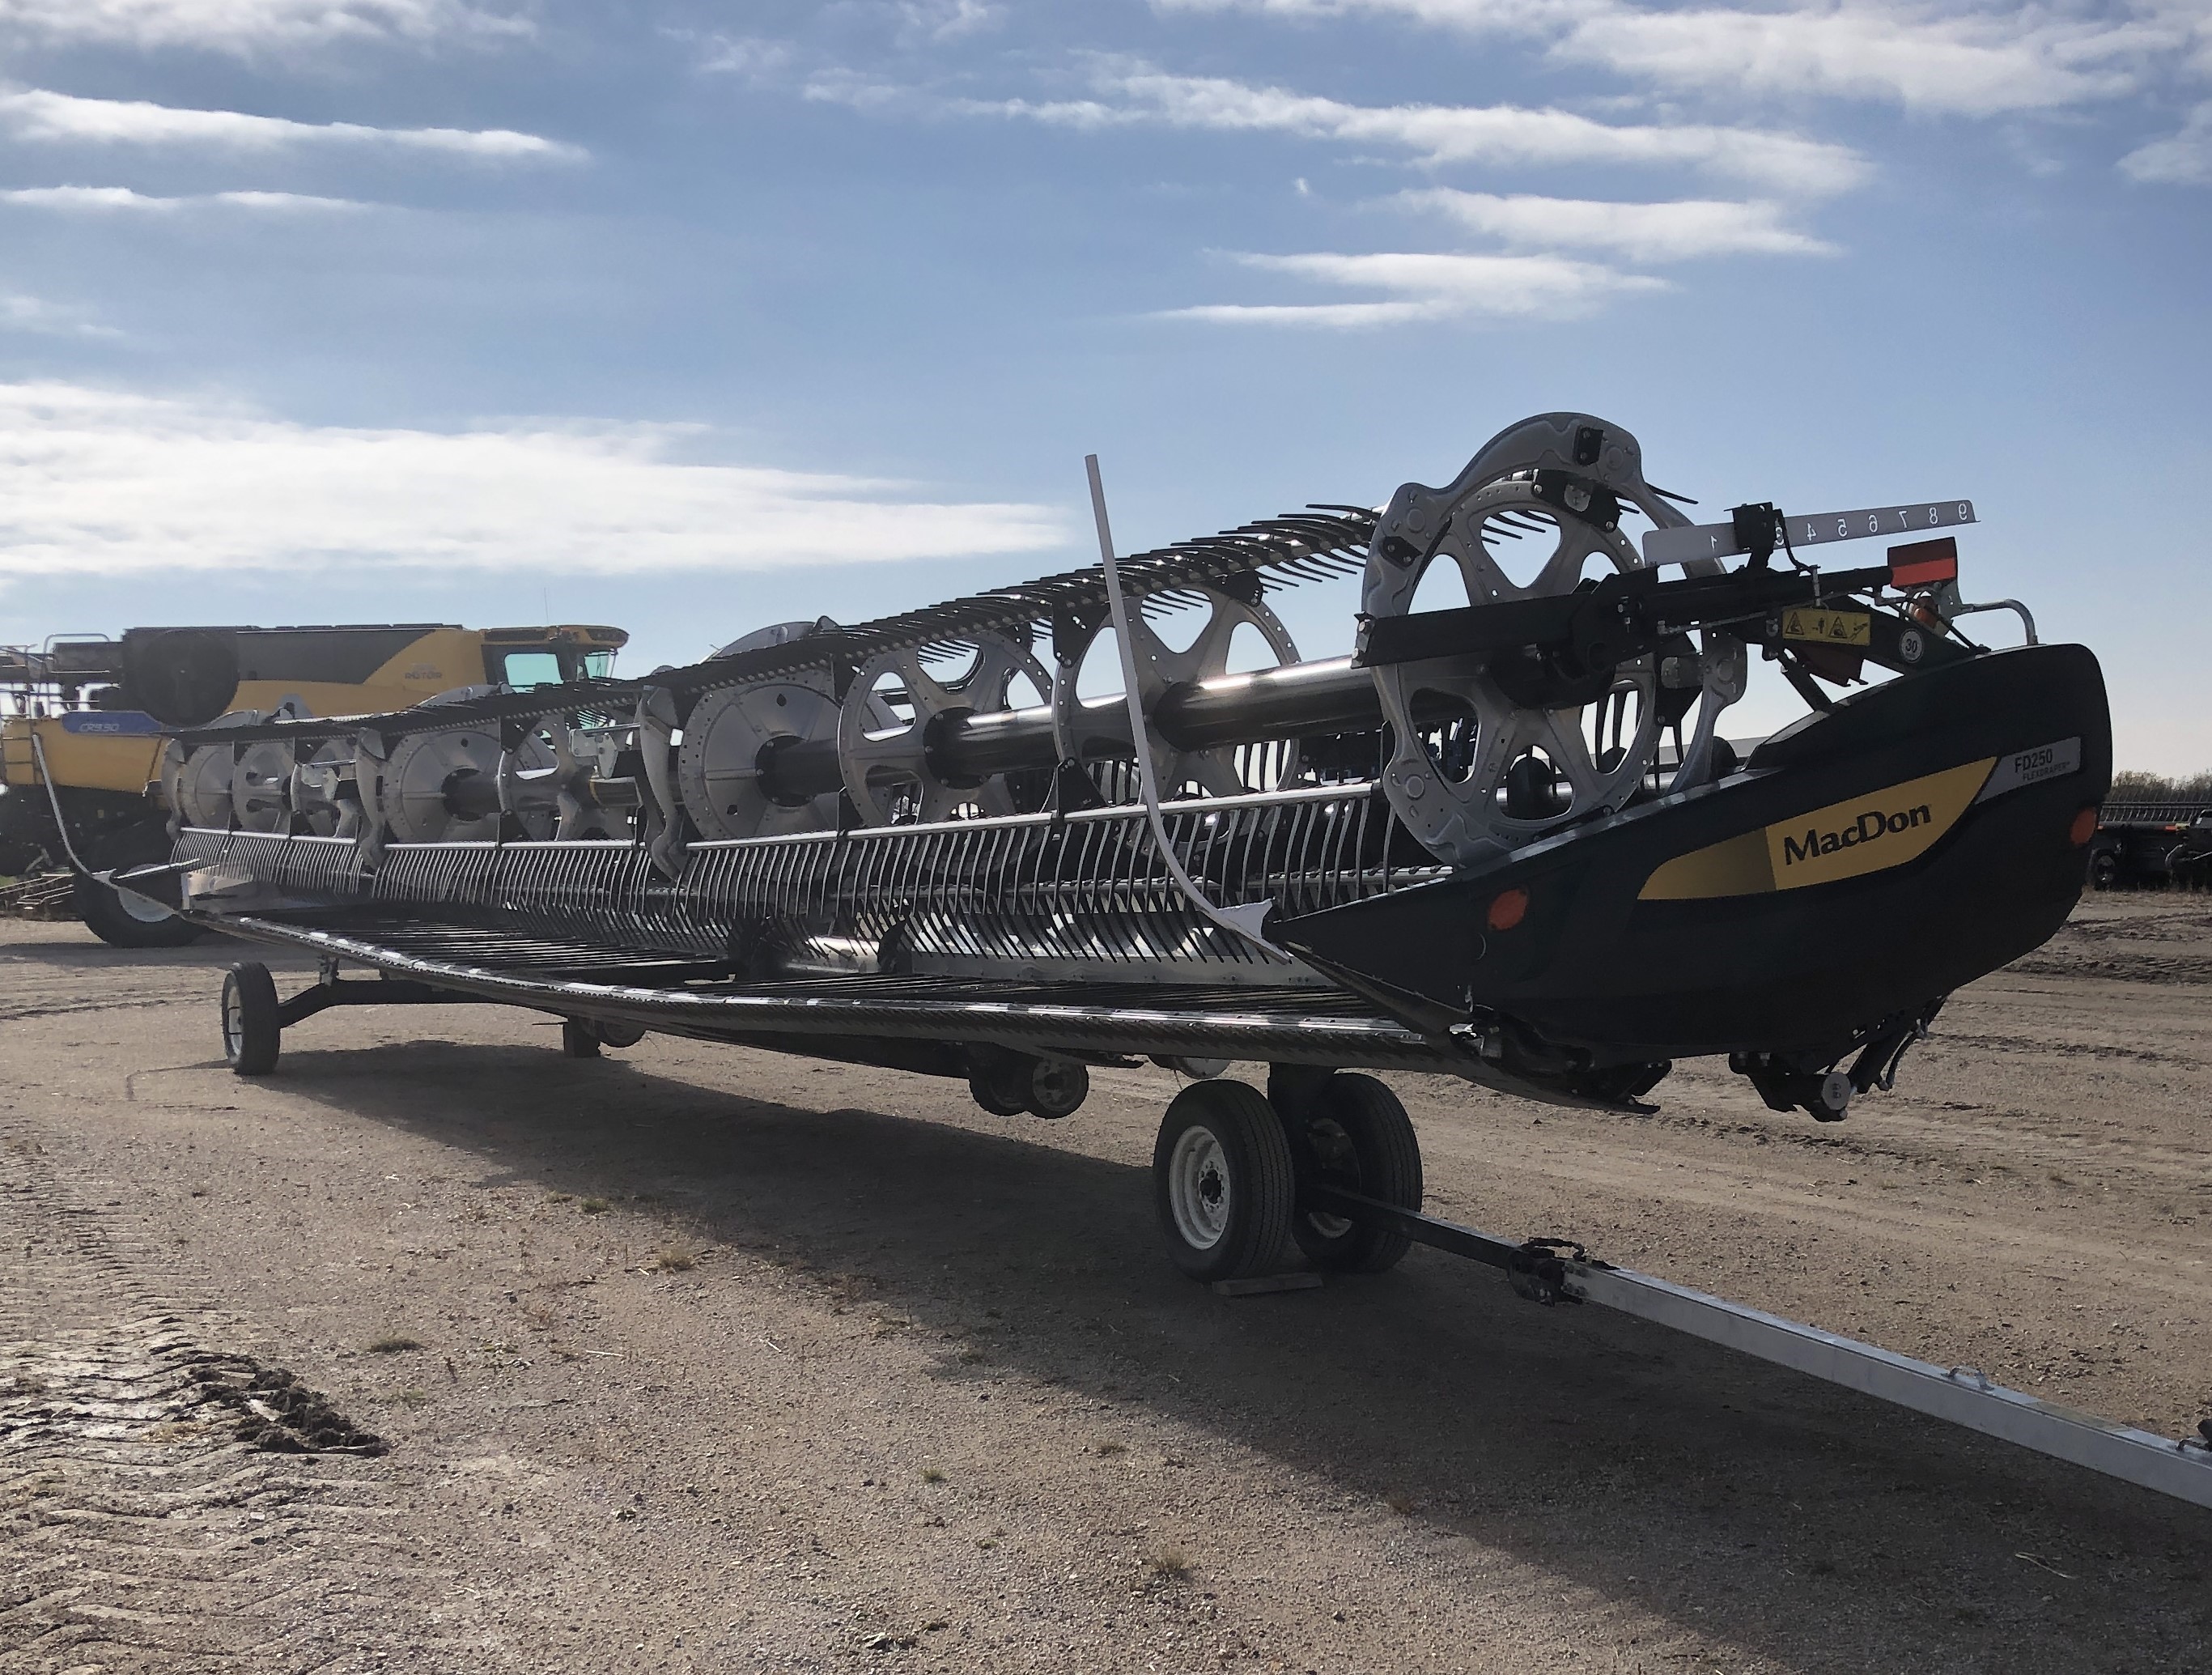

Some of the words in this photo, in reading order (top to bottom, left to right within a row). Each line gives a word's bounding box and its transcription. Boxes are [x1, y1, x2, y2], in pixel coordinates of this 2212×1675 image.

[1905, 638, 1918, 653] 30
[2014, 748, 2053, 774] FD250
[1783, 804, 1931, 865] MacDon
